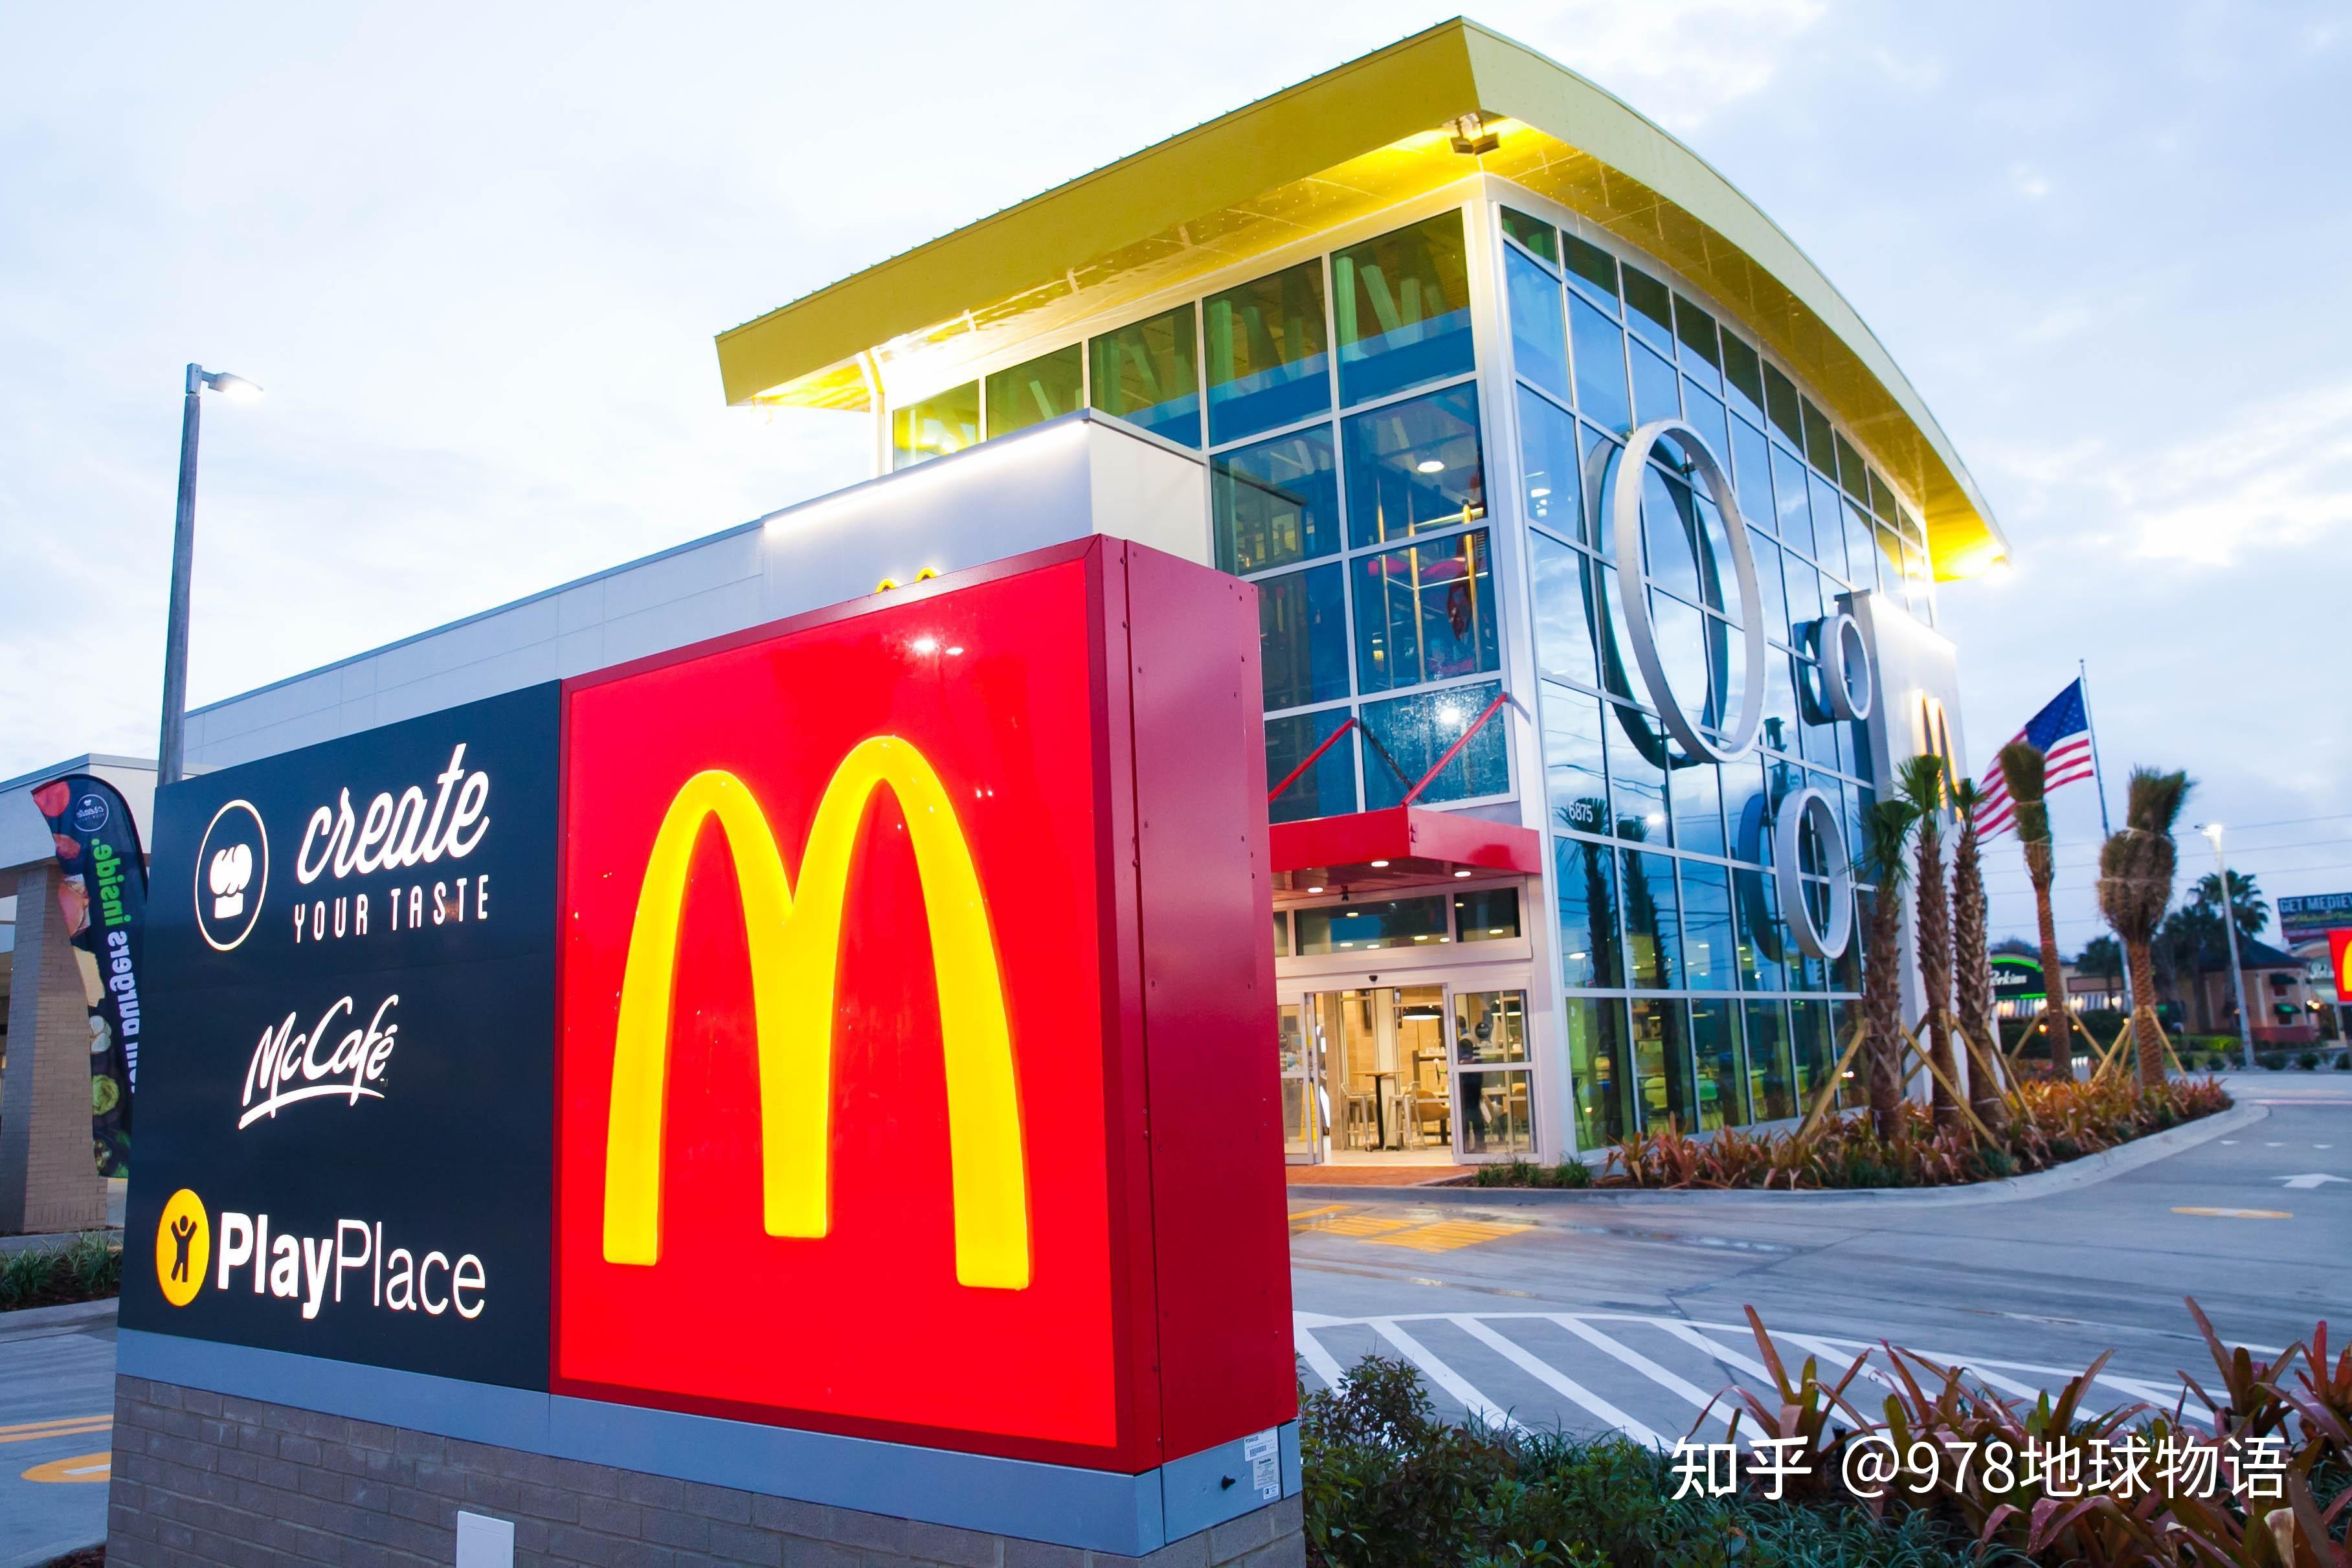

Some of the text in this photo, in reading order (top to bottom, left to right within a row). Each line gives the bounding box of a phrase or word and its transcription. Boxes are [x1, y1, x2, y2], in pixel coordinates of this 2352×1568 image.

[297, 743, 490, 884] create
[1568, 801, 1593, 823] 6875
[294, 874, 489, 943] YOUR TASTE
[2279, 898, 2303, 913] GET
[242, 994, 399, 1120] McCafé
[218, 1212, 486, 1319] PlayPlace
